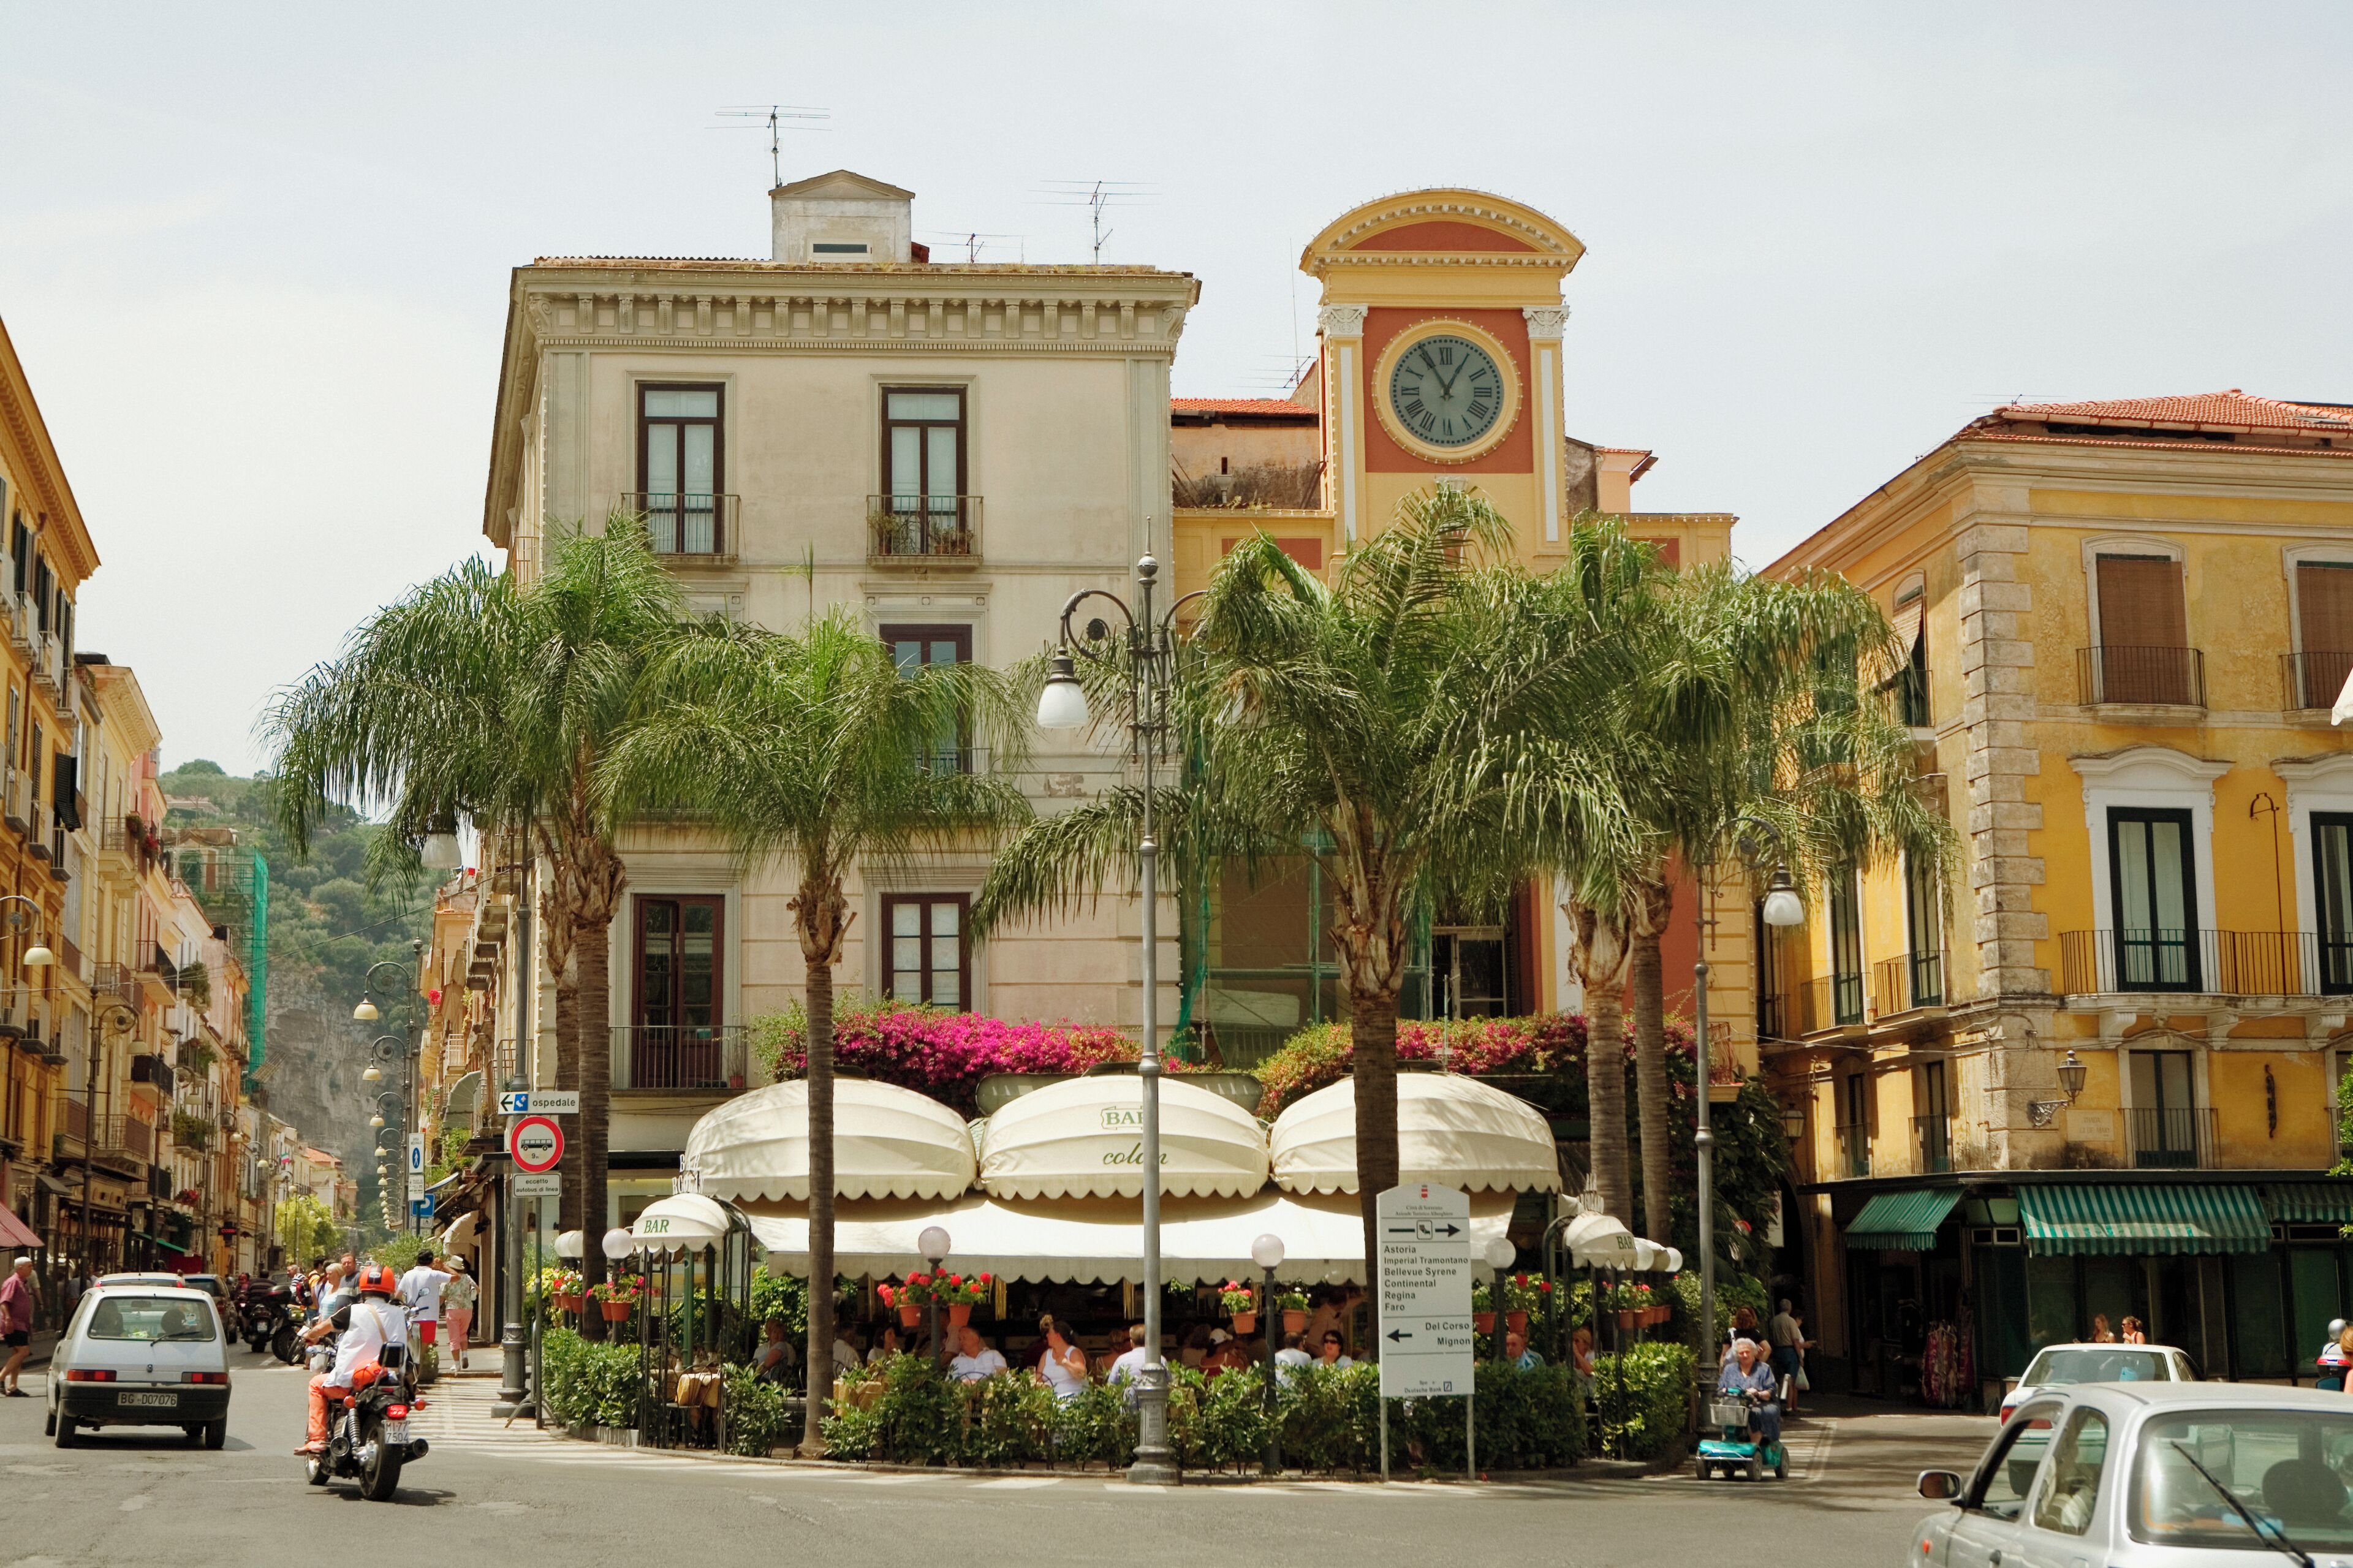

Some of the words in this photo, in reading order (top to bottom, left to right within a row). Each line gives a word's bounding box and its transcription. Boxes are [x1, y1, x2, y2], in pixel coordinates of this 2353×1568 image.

[532, 1098, 575, 1108] ospedale
[644, 1219, 670, 1233] BAR
[1616, 1236, 1634, 1249] BAR
[1384, 1245, 1416, 1254] Astoria
[1384, 1257, 1417, 1266] Imperial
[1384, 1268, 1423, 1276] Bellevue
[1425, 1267, 1457, 1278] Syrene
[1384, 1279, 1436, 1287] Continental
[1385, 1291, 1415, 1301] Regina
[1385, 1303, 1405, 1311] Faro
[1425, 1322, 1440, 1331] Del
[1437, 1337, 1471, 1347] Mignon
[121, 1393, 134, 1404] BG
